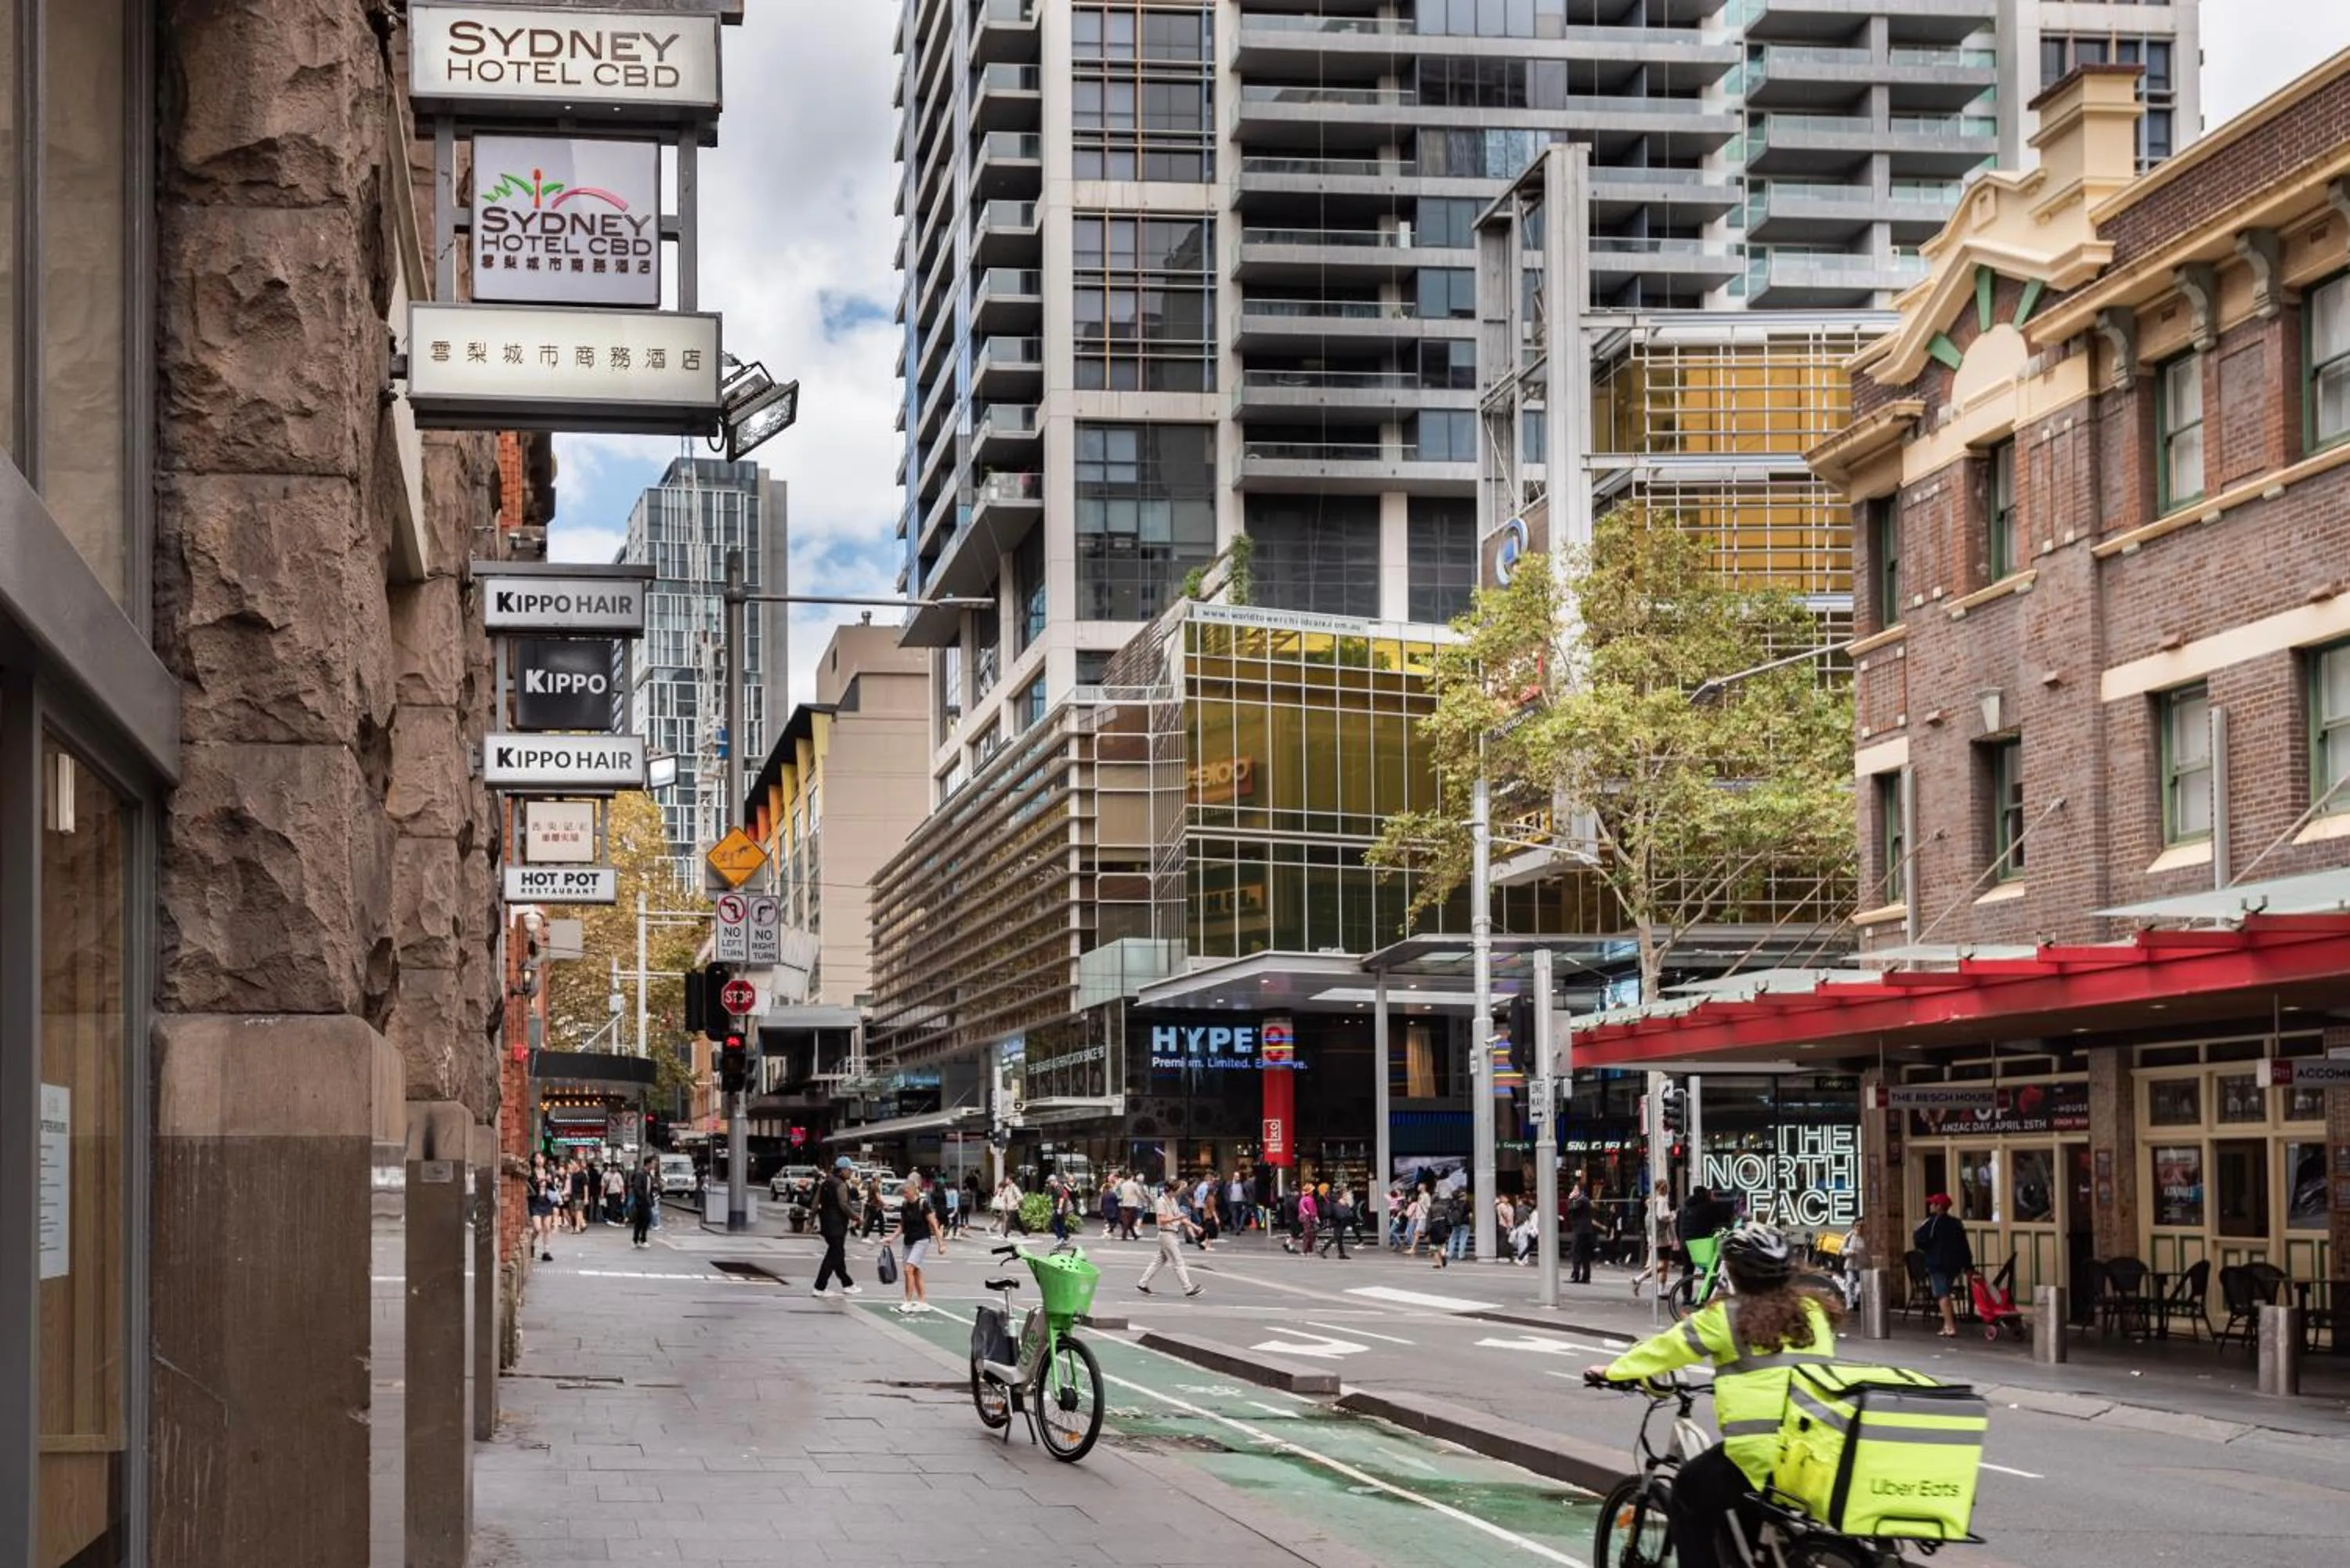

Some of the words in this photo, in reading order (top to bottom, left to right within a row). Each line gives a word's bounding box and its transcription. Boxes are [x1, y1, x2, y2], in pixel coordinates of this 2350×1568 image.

[448, 21, 680, 62] SYDNEY
[447, 60, 580, 85] HOTEL
[593, 63, 680, 88] CBD
[482, 206, 651, 237] SYDNEY
[481, 234, 580, 255] HOTEL
[588, 238, 652, 256] CBD
[431, 341, 701, 370] 雪梨城市商務酒店
[497, 591, 571, 613] KIPPO
[577, 594, 632, 614] HAIR
[526, 669, 607, 694] KIPPO
[497, 747, 571, 769] KIPPO
[577, 751, 632, 769] HAIR
[522, 872, 558, 885] HOT
[564, 873, 600, 886] POT
[724, 927, 741, 937] NO
[755, 930, 773, 940] NO
[725, 991, 753, 1003] STOP
[1152, 1026, 1253, 1053] HYPE
[1891, 1092, 1911, 1102] THE
[1955, 1091, 1994, 1102] HOUSE
[1941, 1122, 1970, 1133] ANZAC
[1768, 1125, 1854, 1154] THE
[1703, 1154, 1854, 1190] NORTH
[1747, 1190, 1855, 1226] FACE
[1871, 1478, 1916, 1496] Uber
[1919, 1480, 1959, 1497] Eats
